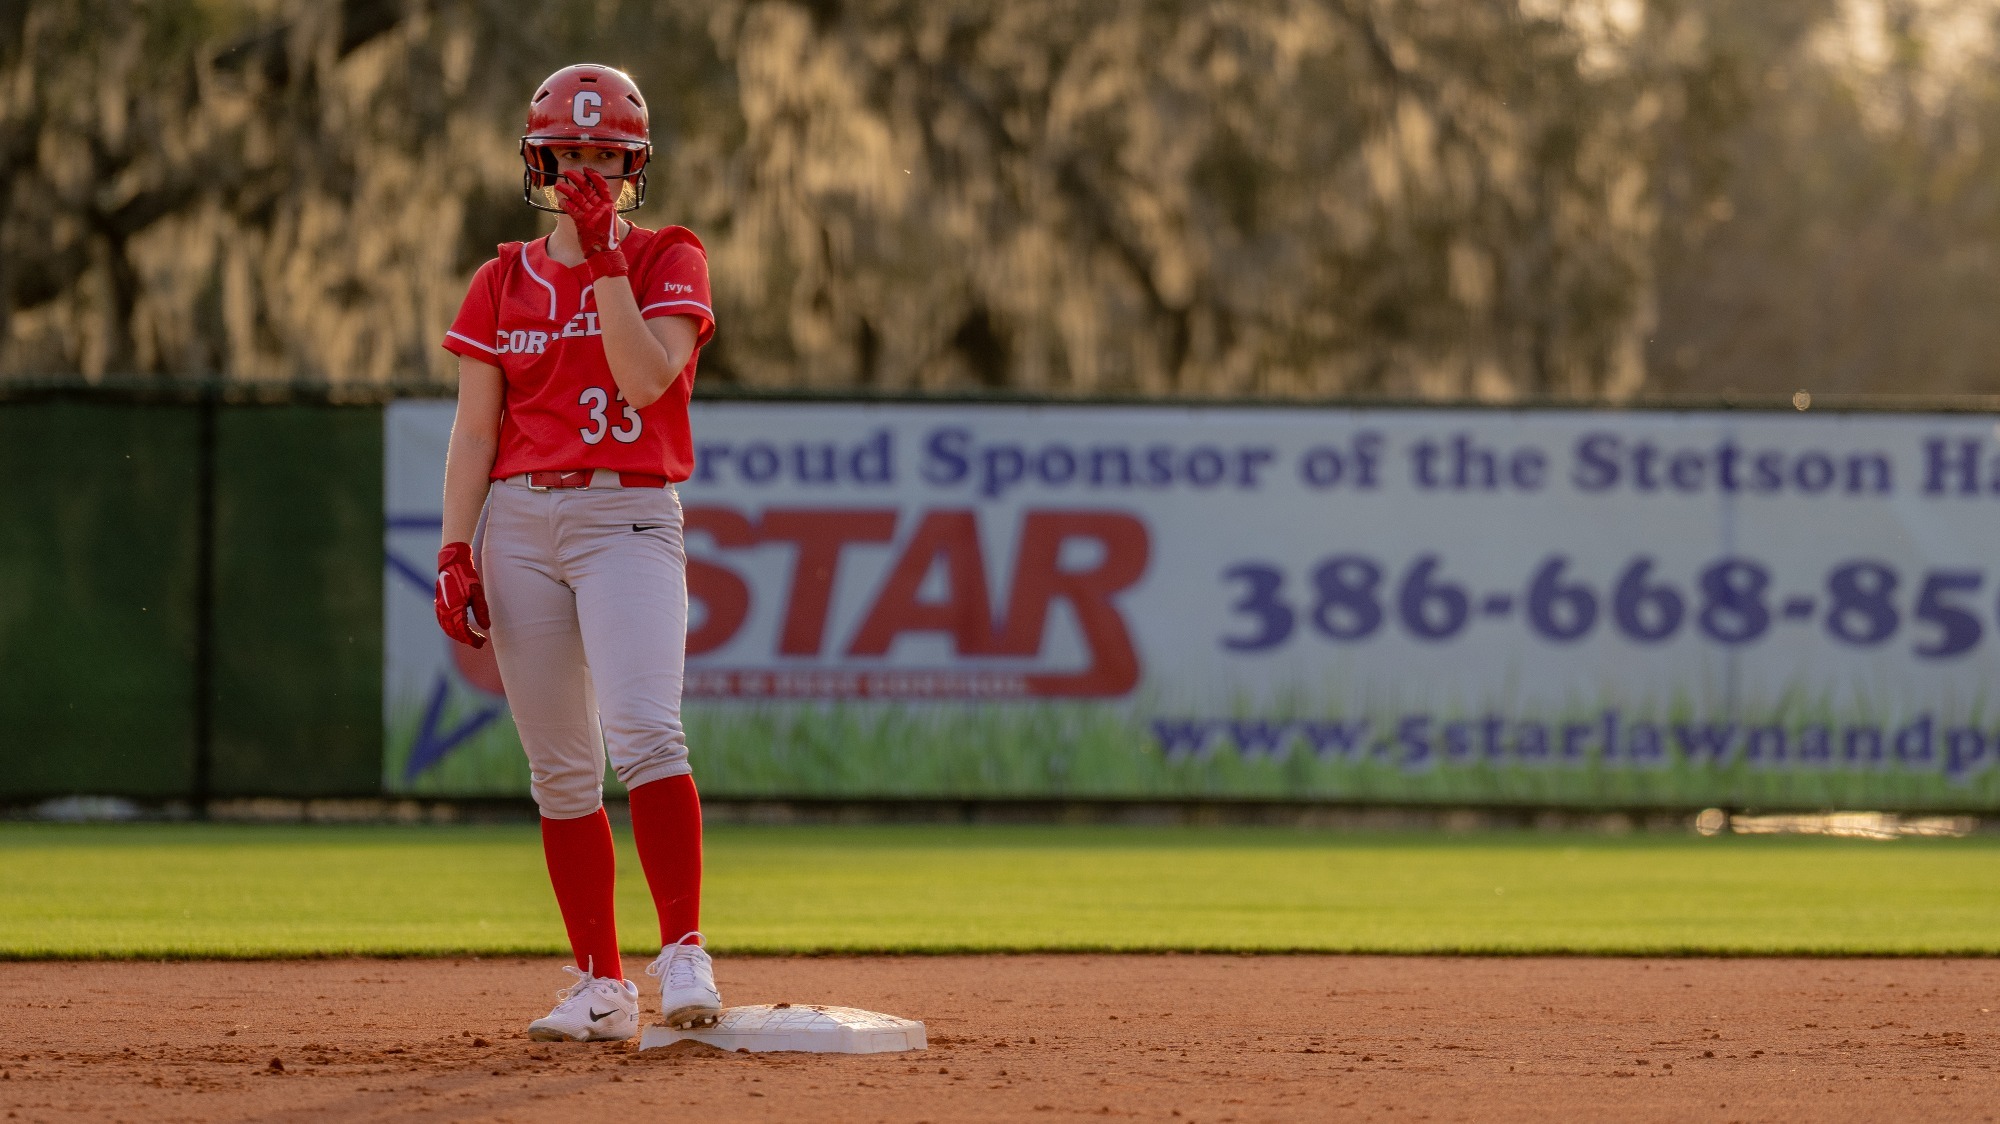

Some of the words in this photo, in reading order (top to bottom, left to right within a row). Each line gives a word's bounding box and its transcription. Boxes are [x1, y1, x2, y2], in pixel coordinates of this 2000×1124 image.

[573, 90, 602, 127] C
[664, 282, 684, 294] Ivy
[496, 311, 602, 354] COREL
[579, 387, 643, 445] 33
[693, 427, 893, 487] roud
[921, 427, 1274, 499] Sponsor
[1303, 430, 1386, 490] of
[1408, 433, 1550, 492] the
[1571, 431, 1894, 496] Stetson
[1922, 436, 2000, 497] H
[1220, 552, 2000, 660] 386-668-85
[1150, 709, 2000, 782] www.5starlawnandp
